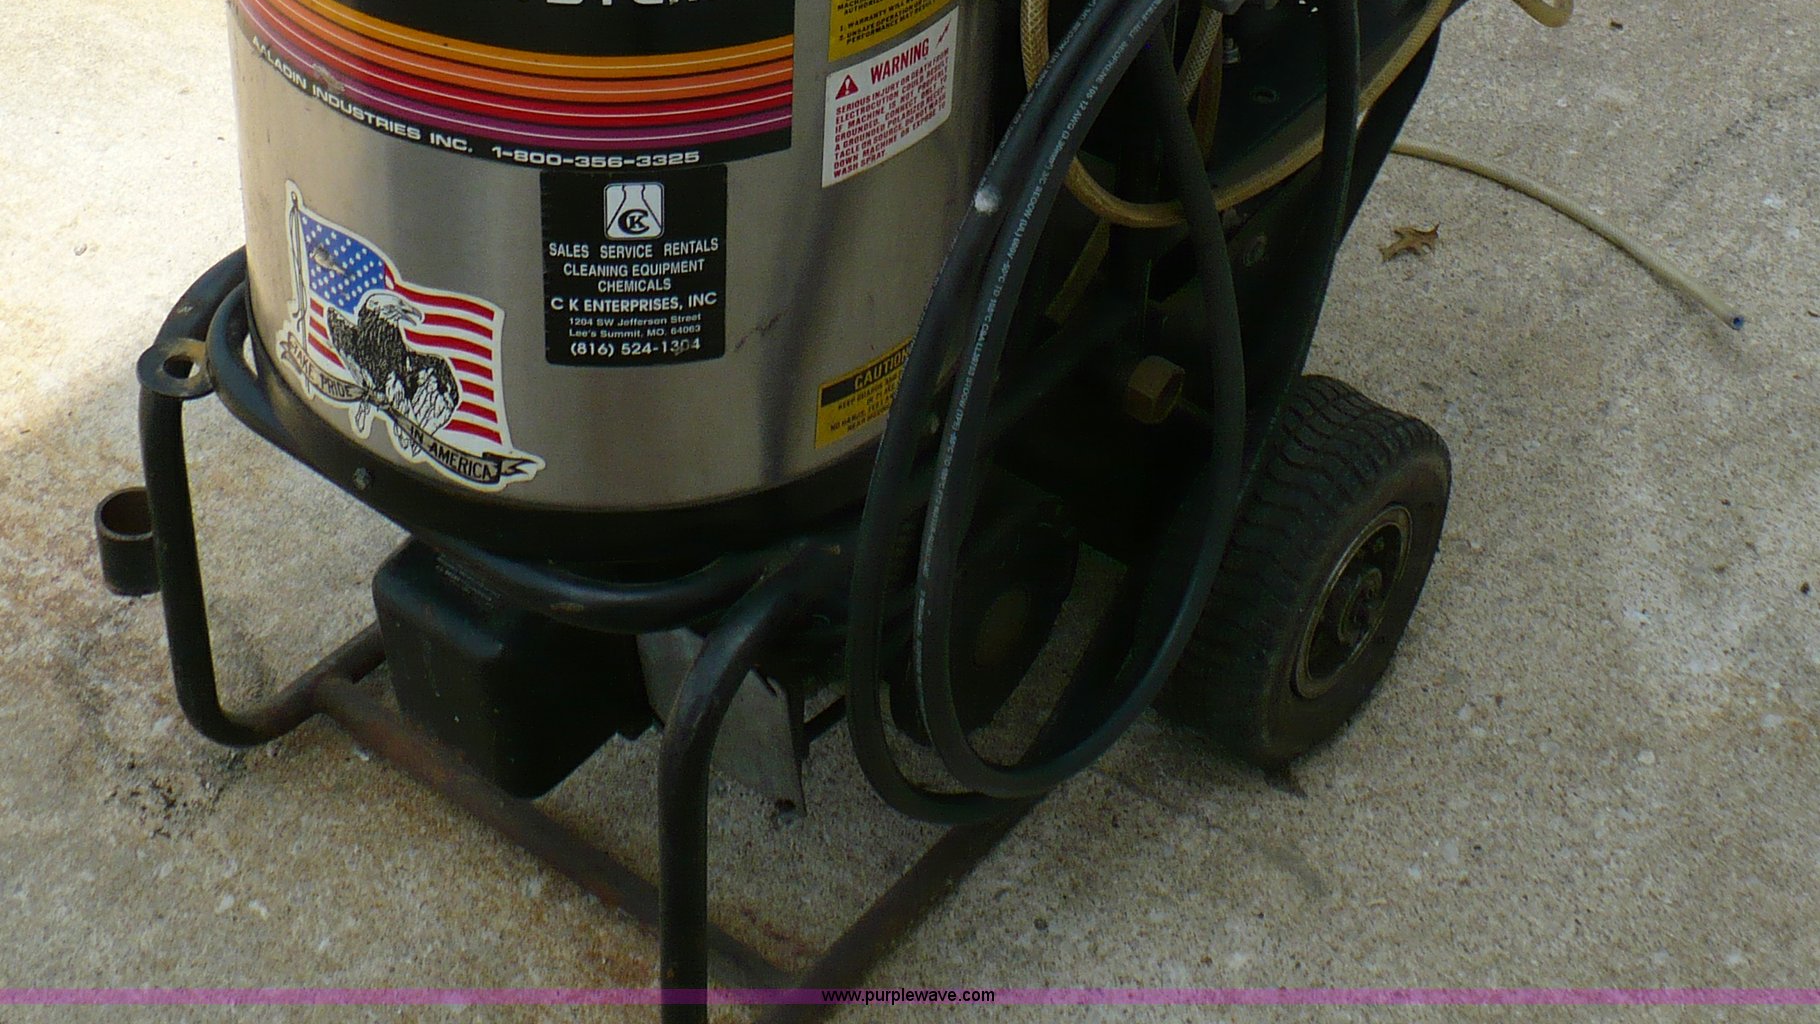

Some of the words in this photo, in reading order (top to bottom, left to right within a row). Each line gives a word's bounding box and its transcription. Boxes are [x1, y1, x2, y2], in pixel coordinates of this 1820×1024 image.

[871, 38, 930, 85] WARNING
[252, 36, 307, 90] AALADIN
[312, 85, 421, 141] INDUSTRIES
[430, 132, 473, 153] INC.
[491, 145, 700, 168] 1-800-356-3325
[836, 95, 870, 114] SERIOUS
[872, 81, 899, 100] INJURY
[836, 91, 898, 124] ELECTROCUTION
[901, 75, 923, 93] COULD
[885, 96, 916, 120] CONNECT
[835, 124, 842, 133] IF
[848, 107, 883, 128] MACHINE
[889, 100, 896, 109] IS
[1067, 109, 1081, 130] AWG
[843, 124, 885, 147] GROUNDED
[834, 154, 858, 169] DOWN
[862, 135, 896, 156] MACHINE
[835, 144, 859, 159] TACLE
[834, 162, 858, 177] WASH
[549, 242, 589, 257] SALES
[600, 244, 653, 258] SERVICE
[664, 238, 719, 256] RENTALS
[563, 263, 628, 277] CLEANING
[632, 259, 705, 276] EQUIPMENT
[598, 278, 671, 293] CHEMICALS
[550, 297, 564, 310] C
[569, 299, 579, 312] K
[584, 297, 683, 312] ENTERPRISES,
[688, 292, 717, 308] INC
[569, 317, 592, 326] 1204
[596, 317, 614, 326] SW
[617, 316, 667, 326] Jefferson
[671, 313, 701, 324] Street
[569, 329, 596, 338] Lee's
[570, 342, 614, 357] (816)
[320, 374, 352, 398] PRIDE
[410, 424, 424, 443] IN
[429, 442, 492, 481] AMERICA
